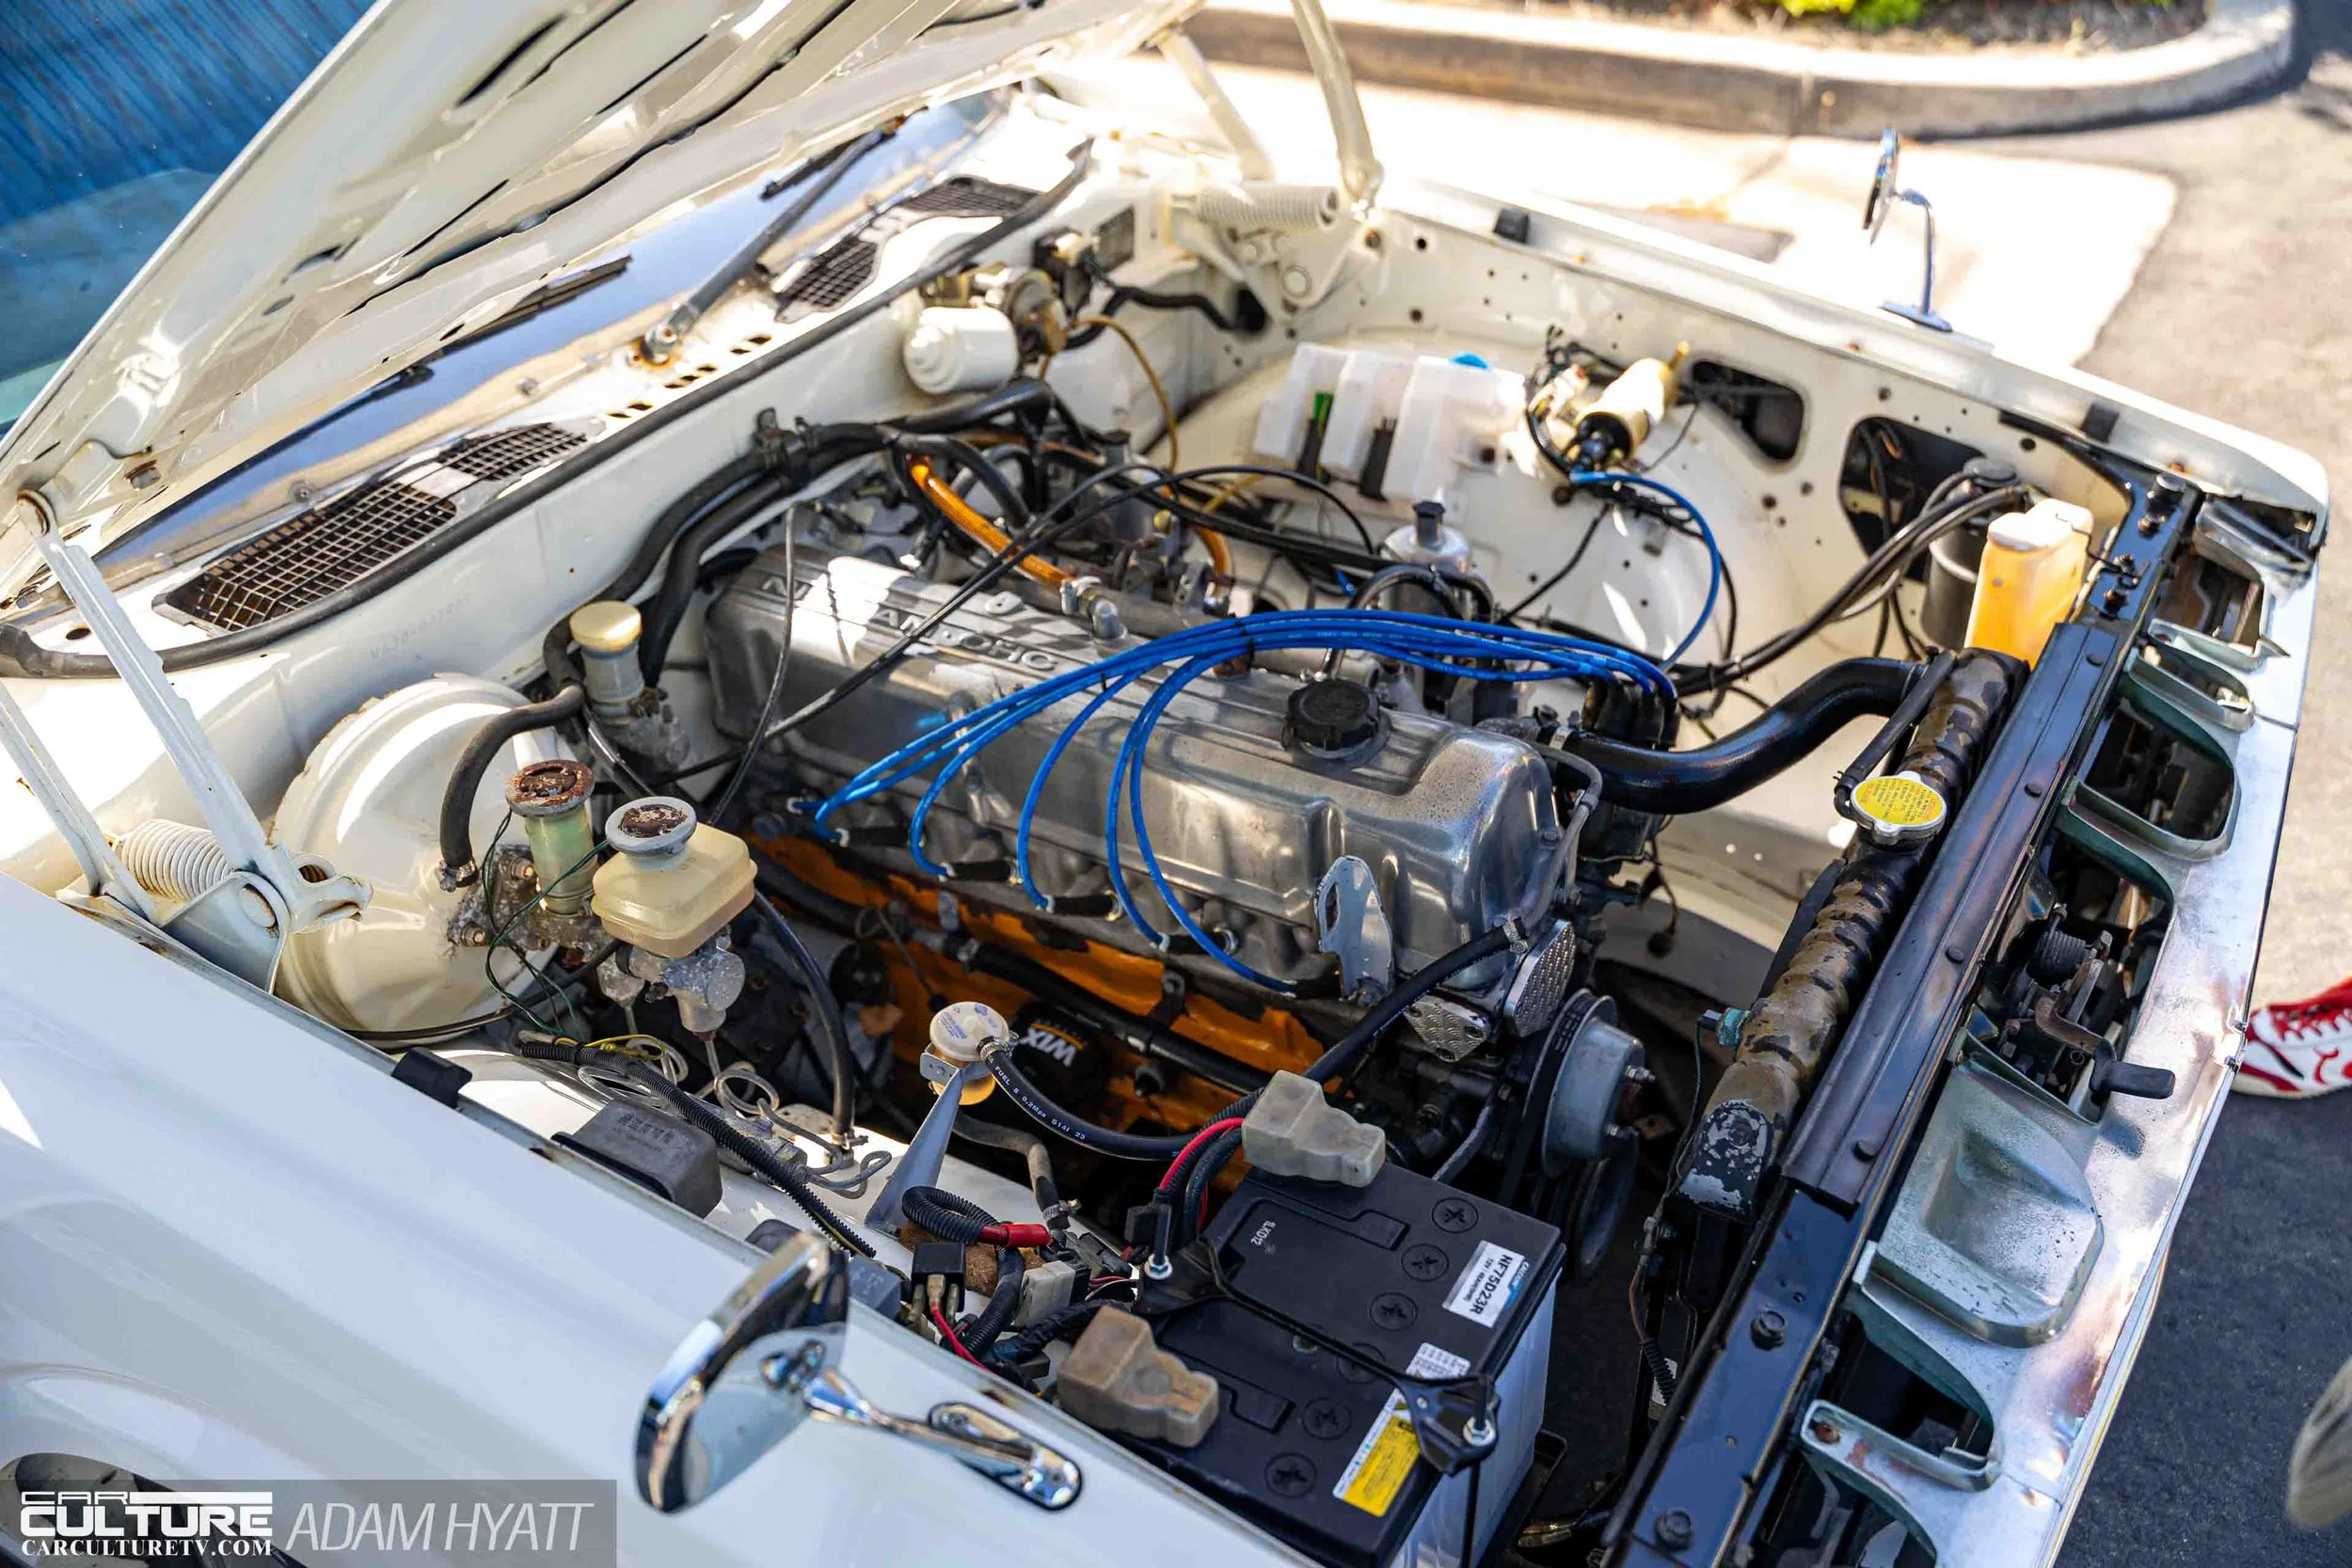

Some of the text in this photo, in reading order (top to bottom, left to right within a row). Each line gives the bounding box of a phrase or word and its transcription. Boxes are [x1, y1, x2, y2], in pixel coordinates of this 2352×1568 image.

[1019, 1028, 1076, 1068] WIX
[994, 1065, 1010, 1085] FUEL
[1074, 1132, 1086, 1140] 23
[1470, 1254, 1514, 1315] NF75D23R
